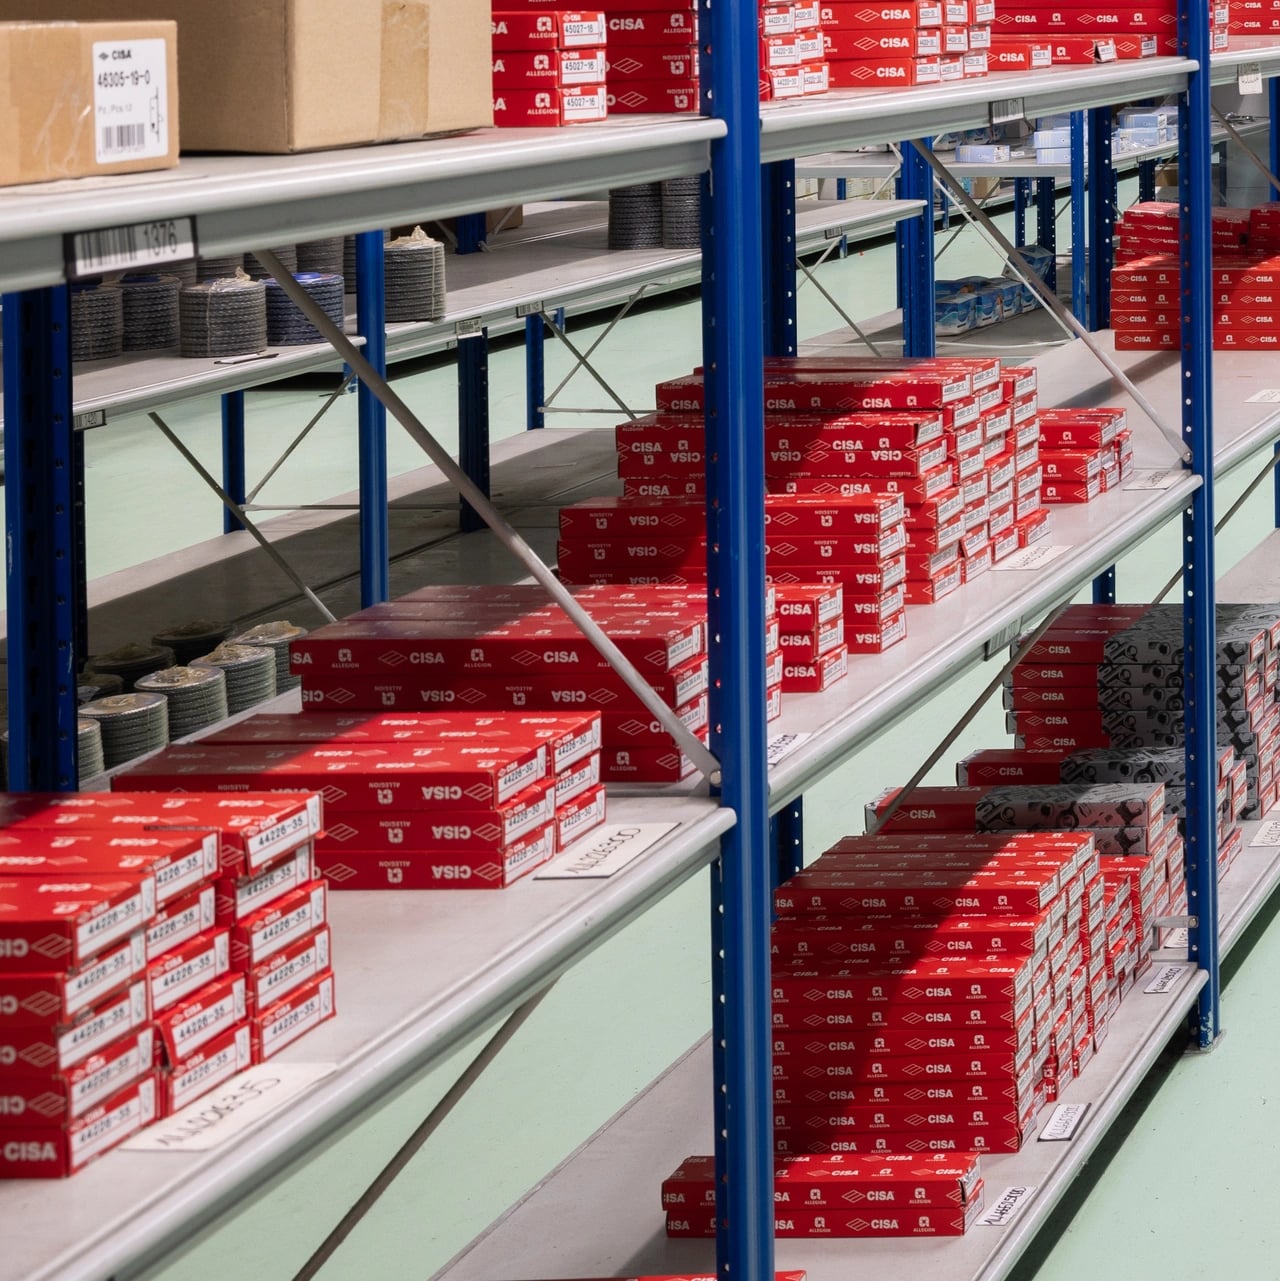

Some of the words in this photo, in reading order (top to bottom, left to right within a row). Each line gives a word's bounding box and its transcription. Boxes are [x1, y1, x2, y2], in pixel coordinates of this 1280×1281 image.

[881, 10, 910, 20] CISA
[565, 24, 593, 33] 45027-16
[112, 50, 131, 60] CISA
[565, 61, 594, 70] 45027-16
[567, 98, 595, 107] 45027-16
[144, 223, 177, 257] 1376
[863, 398, 892, 409] CISA
[632, 442, 662, 452] CISA
[629, 515, 658, 526] CISA
[780, 604, 811, 615] CISA
[410, 652, 444, 664] CISA
[544, 651, 578, 663] CISA
[1041, 670, 1063, 678] CISA
[421, 690, 455, 702] CISA
[999, 768, 1023, 776] CISA
[422, 786, 462, 799] CISA
[432, 826, 471, 839] CISA
[955, 898, 979, 907] CISA
[827, 990, 853, 999] CISA
[926, 988, 952, 997] CISA
[927, 1089, 953, 1098] CISA
[929, 1140, 955, 1149] CISA
[867, 1191, 894, 1202] CISA
[871, 1220, 899, 1230] CISA
